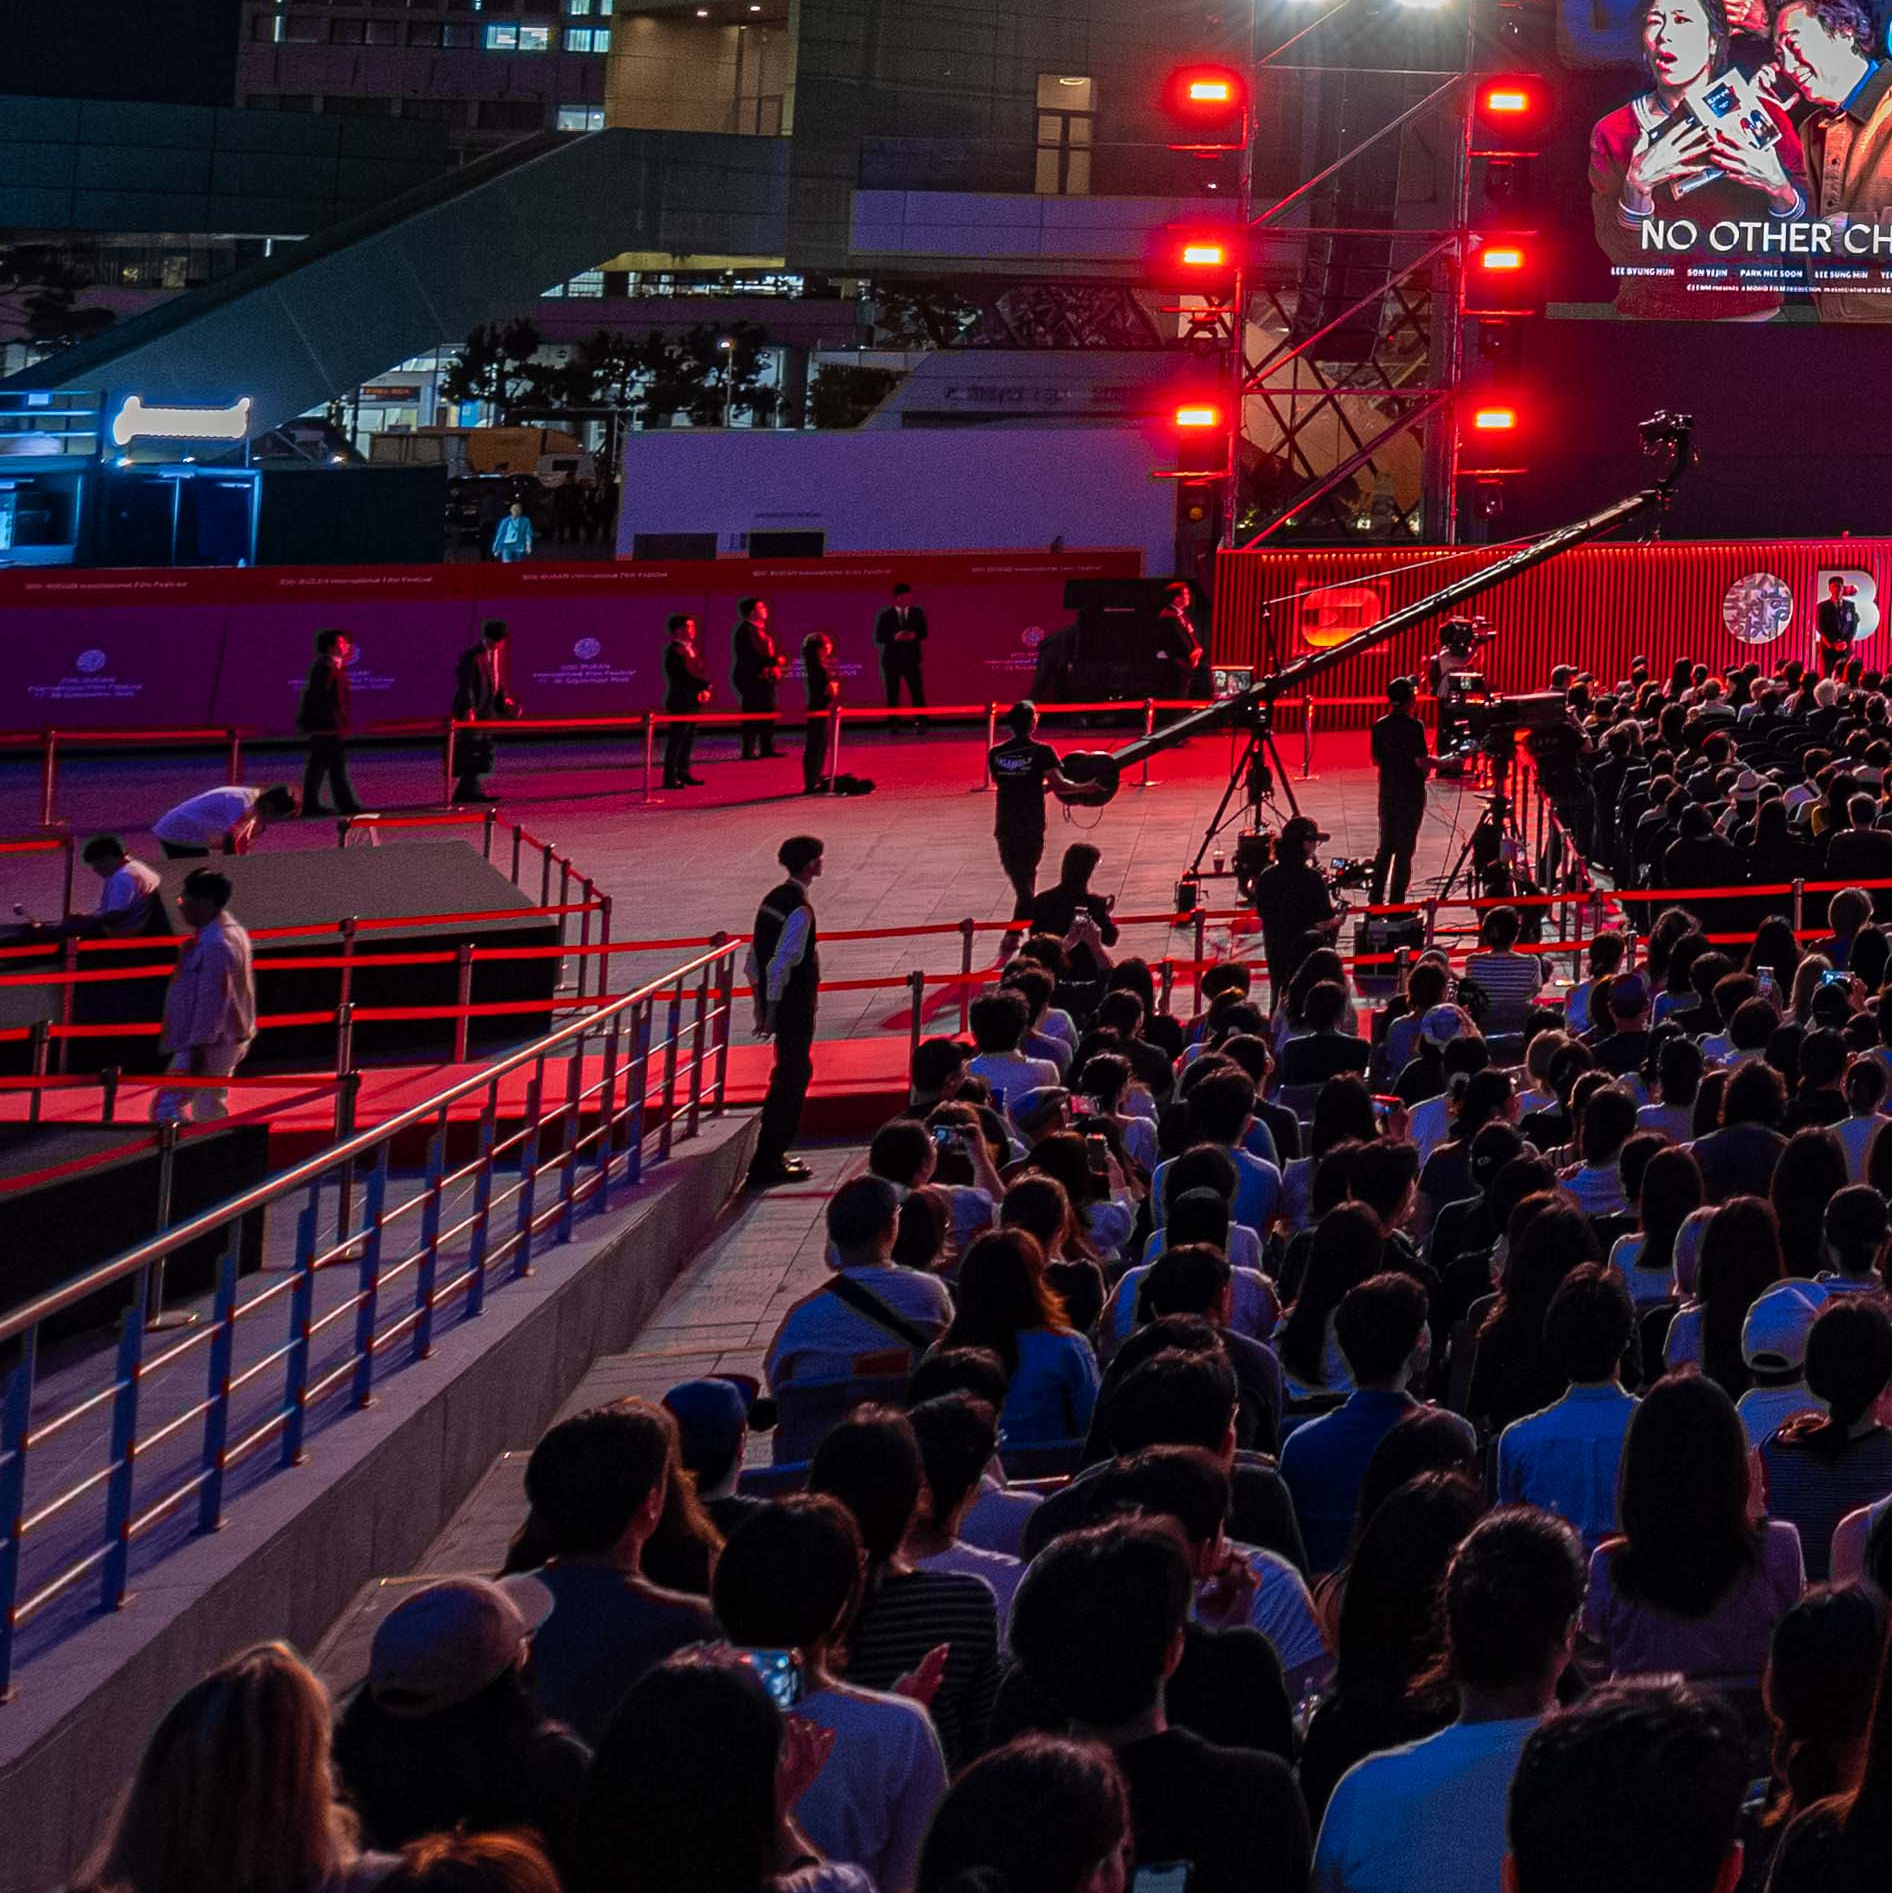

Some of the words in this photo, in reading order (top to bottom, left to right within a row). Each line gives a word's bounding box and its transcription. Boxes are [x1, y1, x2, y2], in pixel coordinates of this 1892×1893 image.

[1640, 220, 1698, 251] NO
[1708, 220, 1832, 254] OTHER
[1687, 268, 1705, 278] SON
[1740, 268, 1762, 279] PARK
[1780, 269, 1803, 279] SOON
[1830, 271, 1852, 280] SUNG
